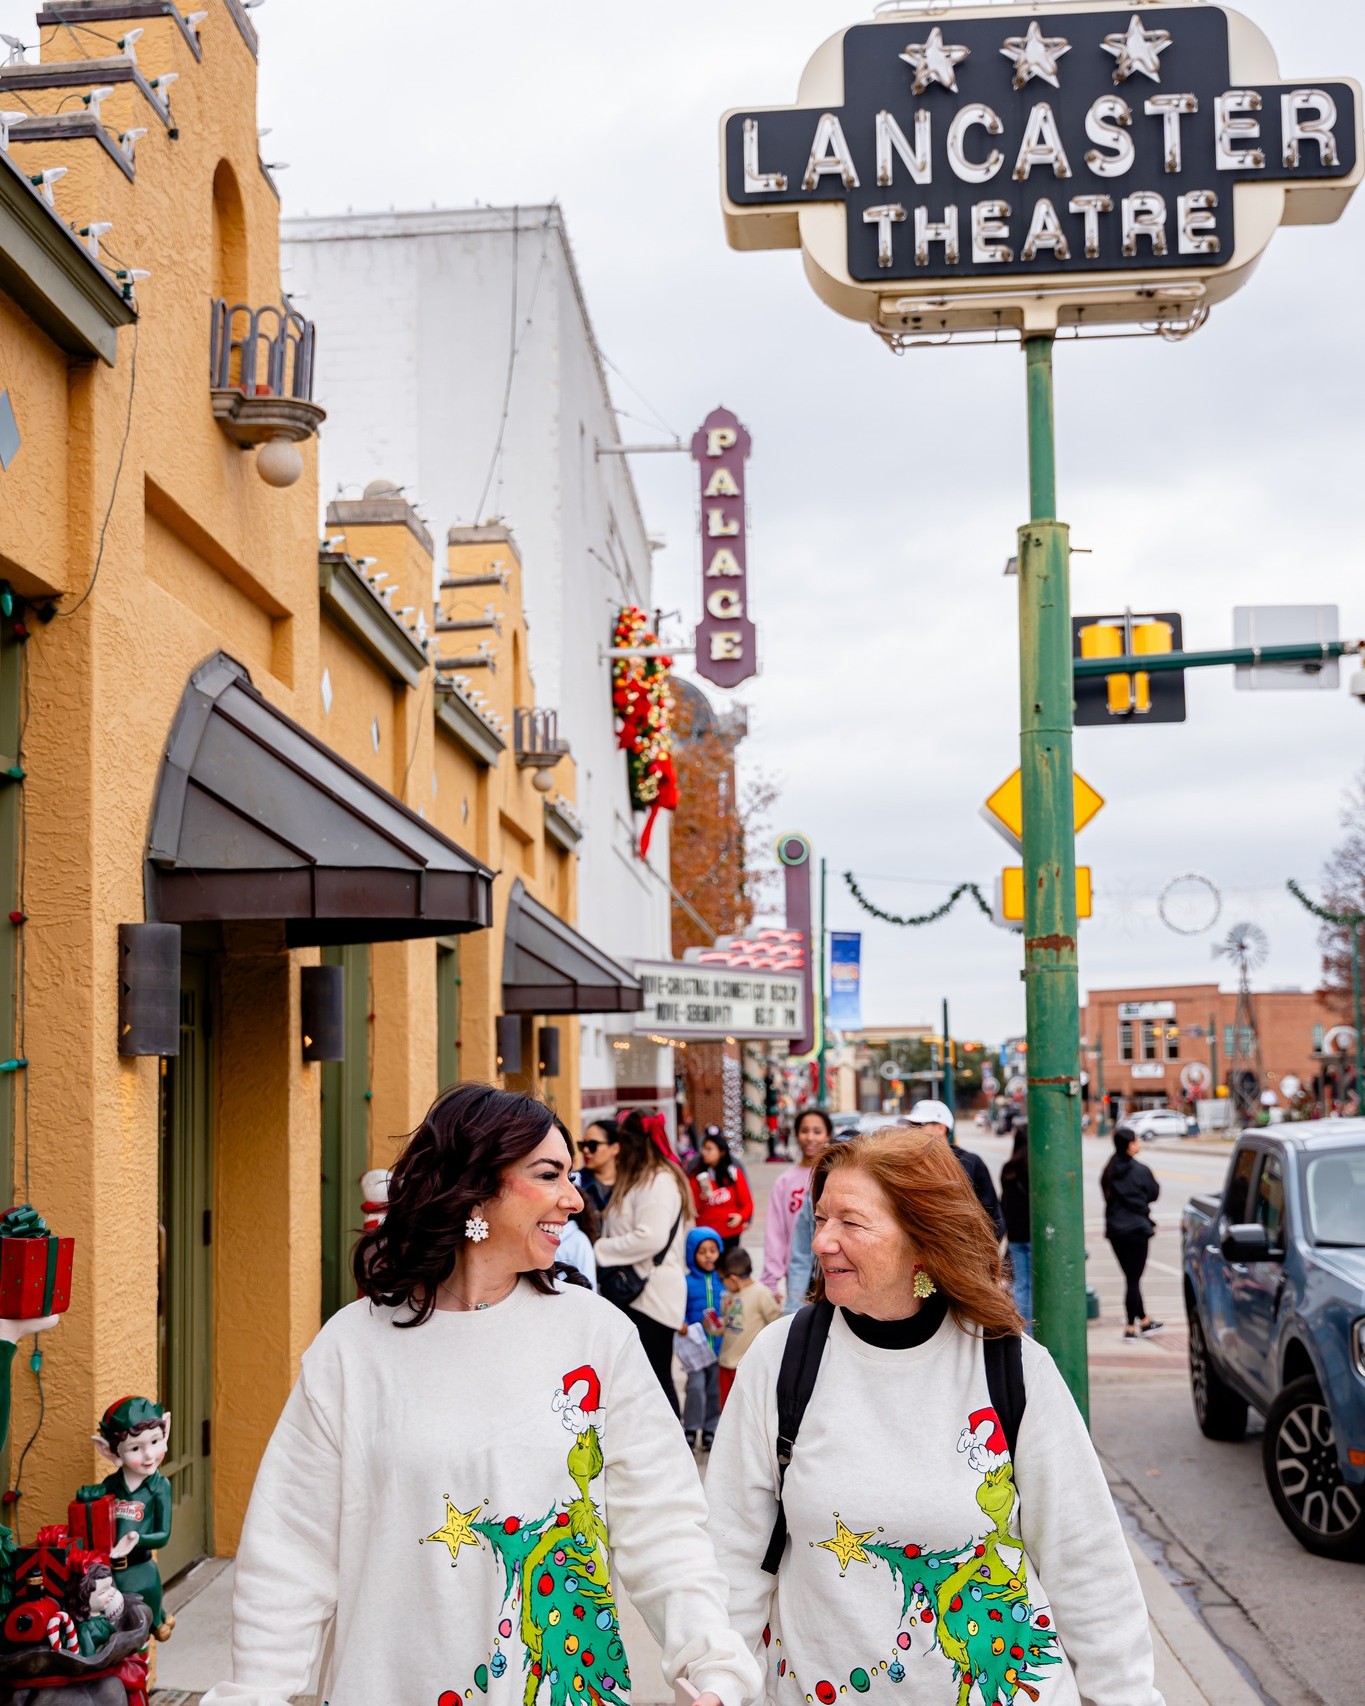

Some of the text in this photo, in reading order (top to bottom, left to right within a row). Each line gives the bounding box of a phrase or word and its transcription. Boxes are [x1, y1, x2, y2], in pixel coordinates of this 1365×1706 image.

[742, 89, 1340, 193] LANCASTER
[862, 190, 1221, 269] THEATRE
[704, 427, 744, 662] PALACE
